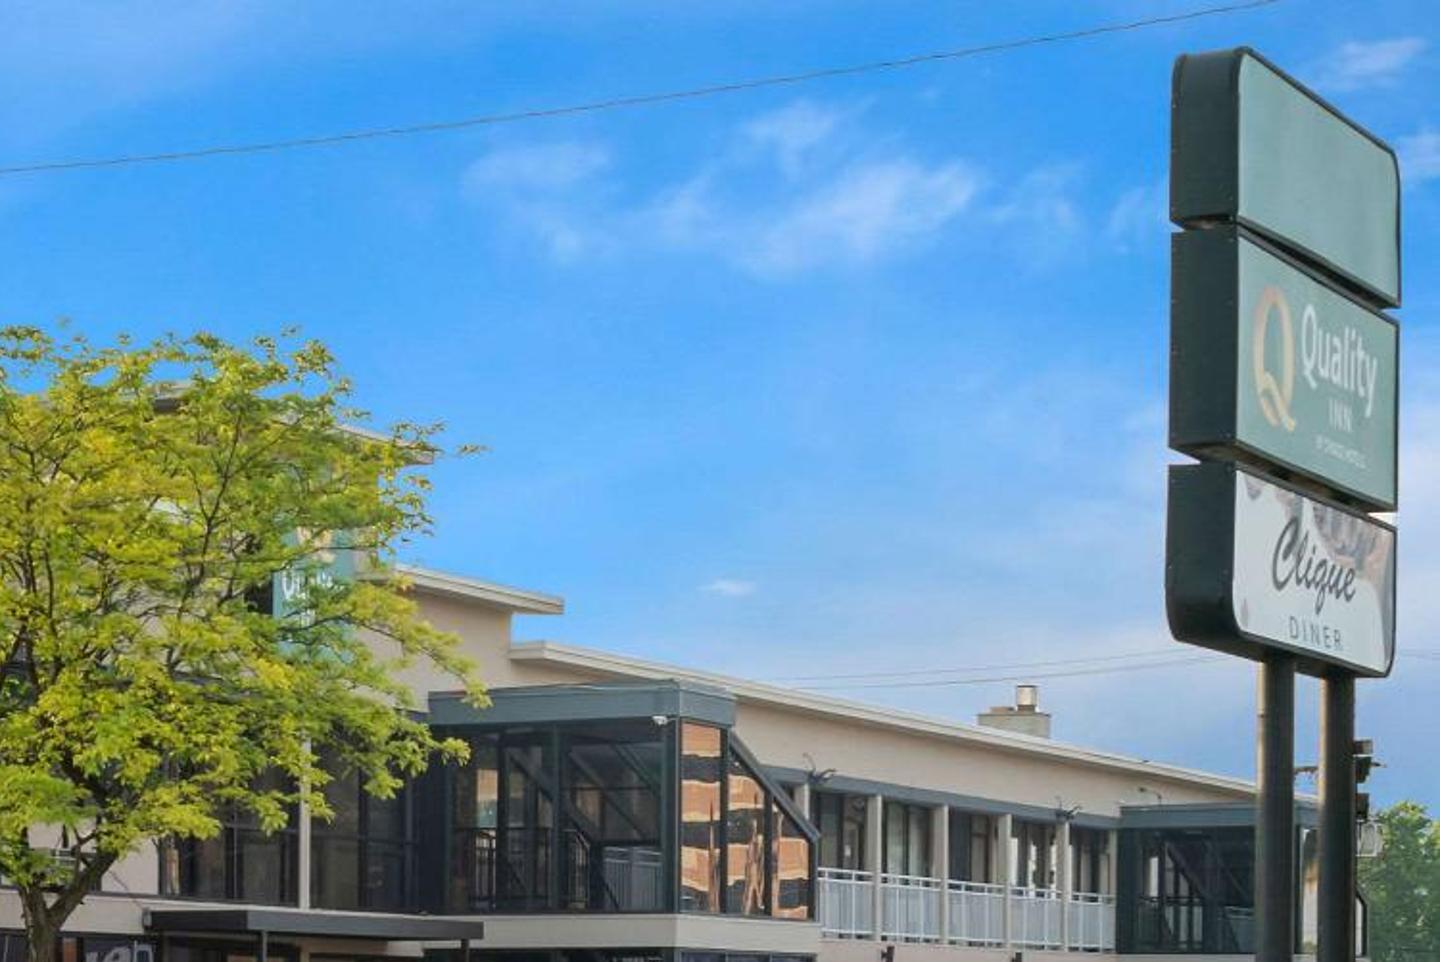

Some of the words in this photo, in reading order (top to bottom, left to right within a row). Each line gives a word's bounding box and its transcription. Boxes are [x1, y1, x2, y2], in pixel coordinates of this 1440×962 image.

[1301, 304, 1377, 418] Quality
[1328, 398, 1353, 432] INN
[1272, 516, 1356, 615] Clique
[1289, 616, 1343, 650] DINER
